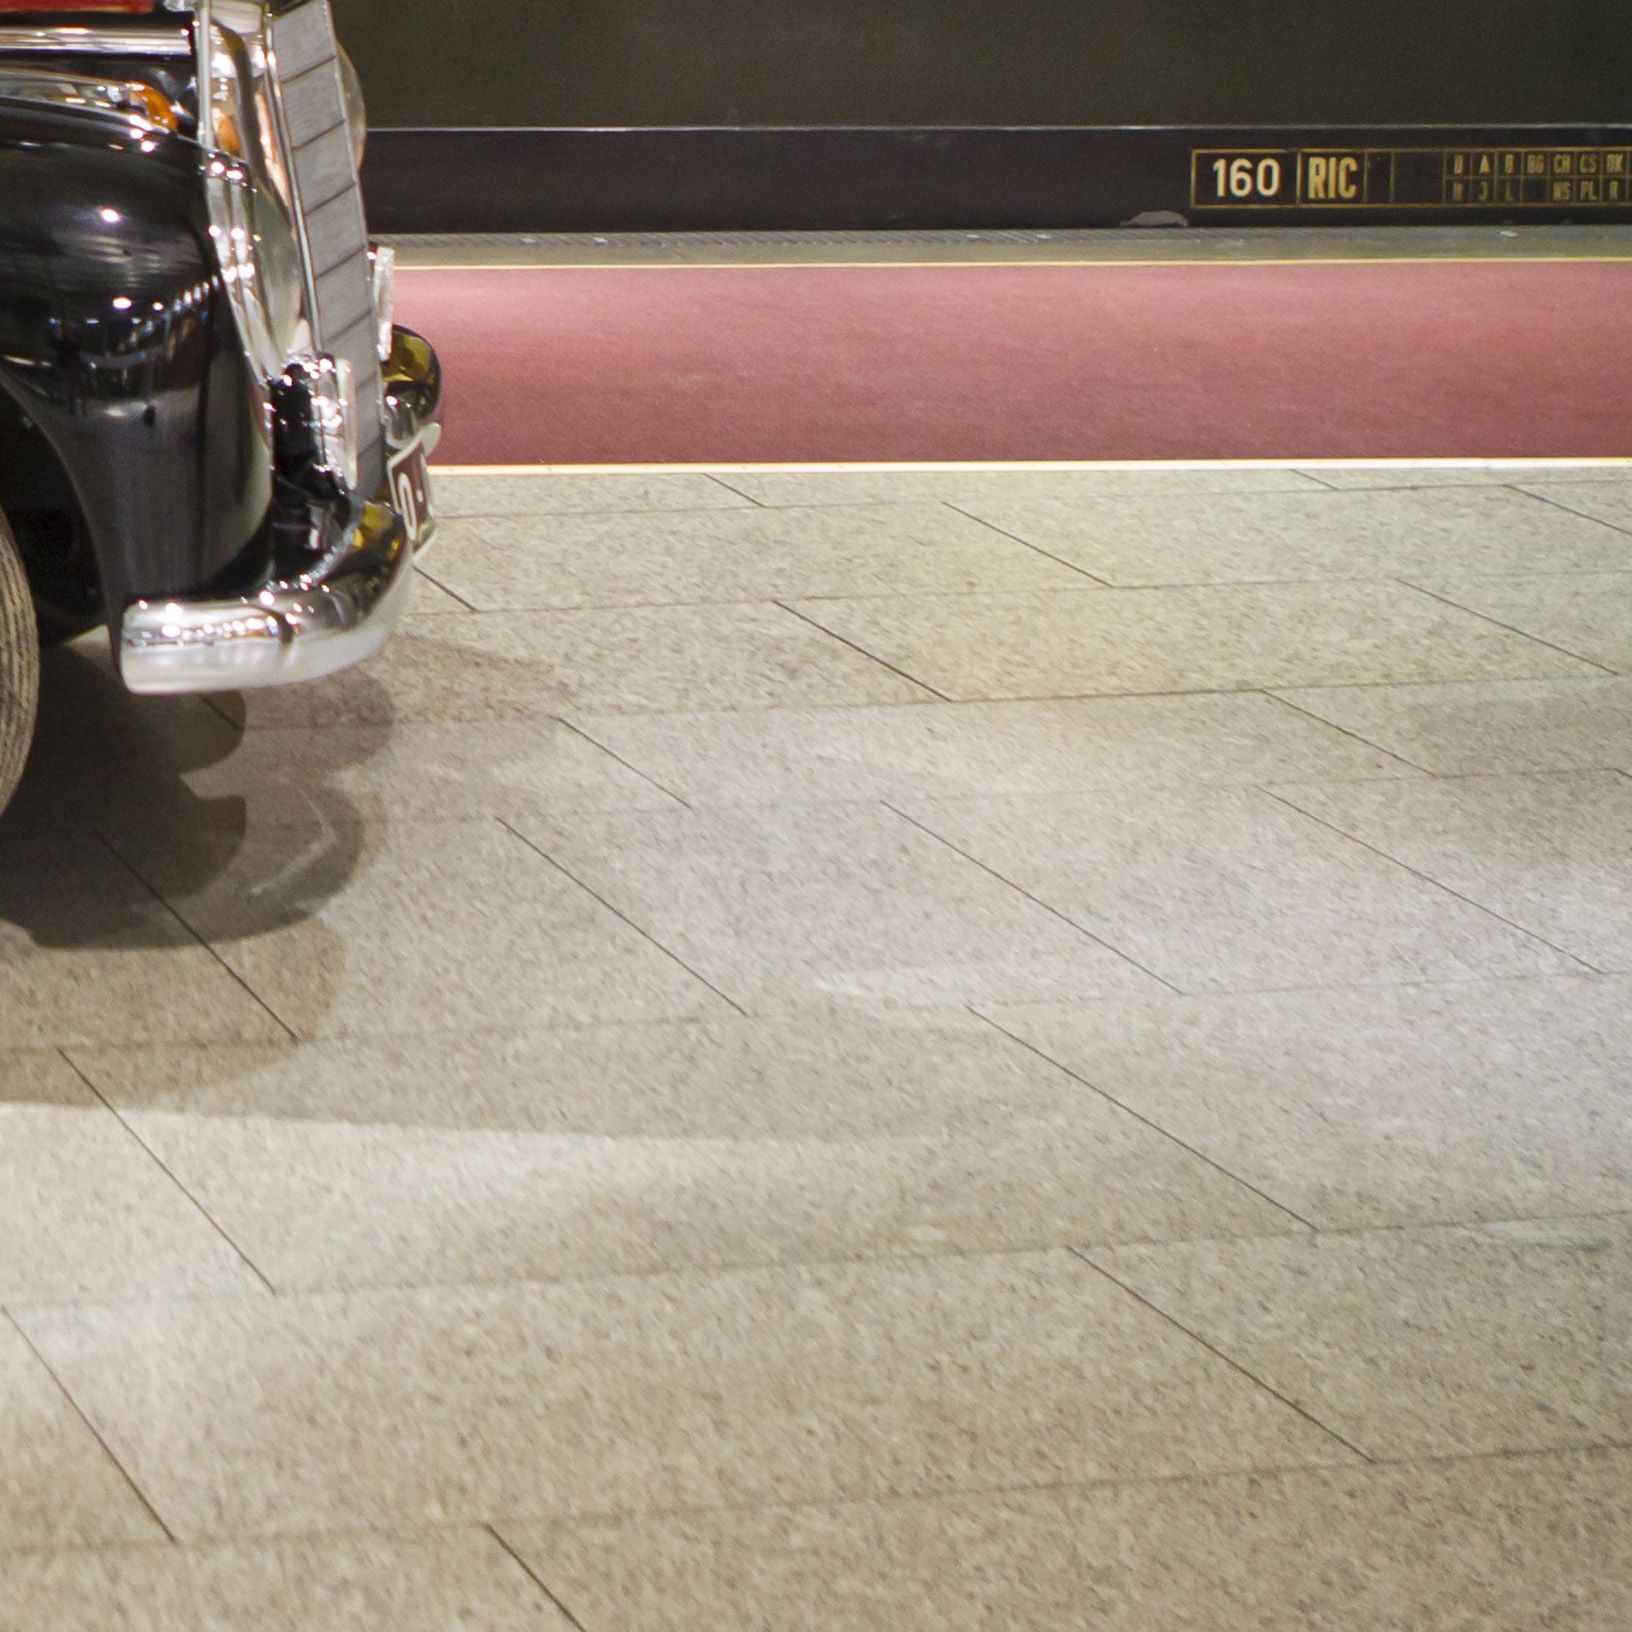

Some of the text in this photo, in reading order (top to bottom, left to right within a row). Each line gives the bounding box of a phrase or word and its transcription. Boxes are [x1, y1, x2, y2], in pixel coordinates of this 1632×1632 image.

[1212, 155, 1359, 200] 160 RIC
[1478, 153, 1491, 175] A
[1552, 152, 1572, 174] CH
